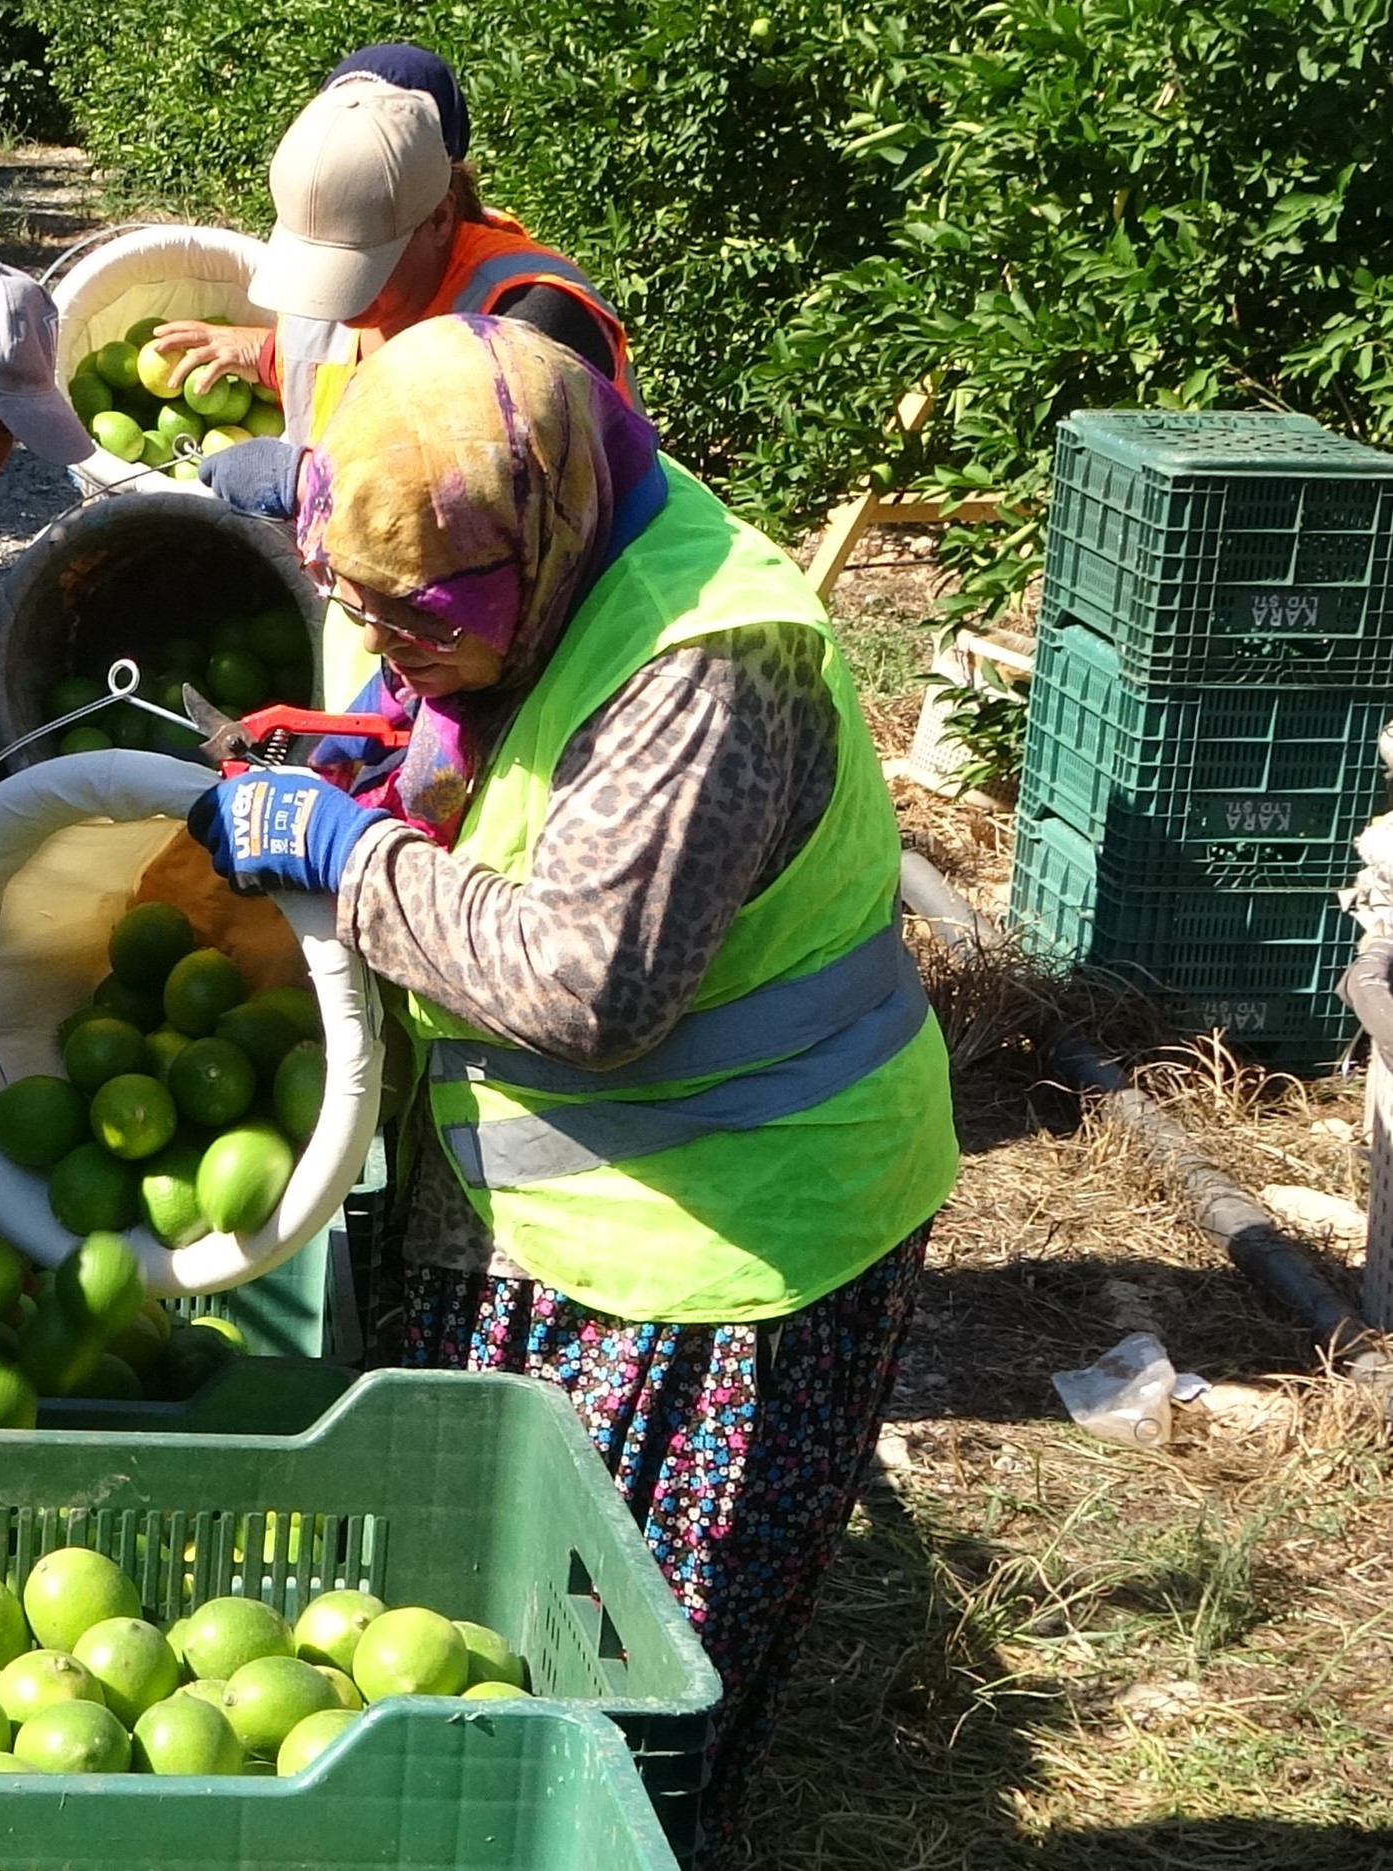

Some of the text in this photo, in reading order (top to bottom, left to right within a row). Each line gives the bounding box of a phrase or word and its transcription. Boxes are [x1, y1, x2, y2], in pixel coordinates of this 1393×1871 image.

[1252, 607, 1317, 626] KARA
[232, 782, 257, 859] uvex
[1226, 812, 1290, 831] KARA
[1203, 1012, 1265, 1030] KARA
